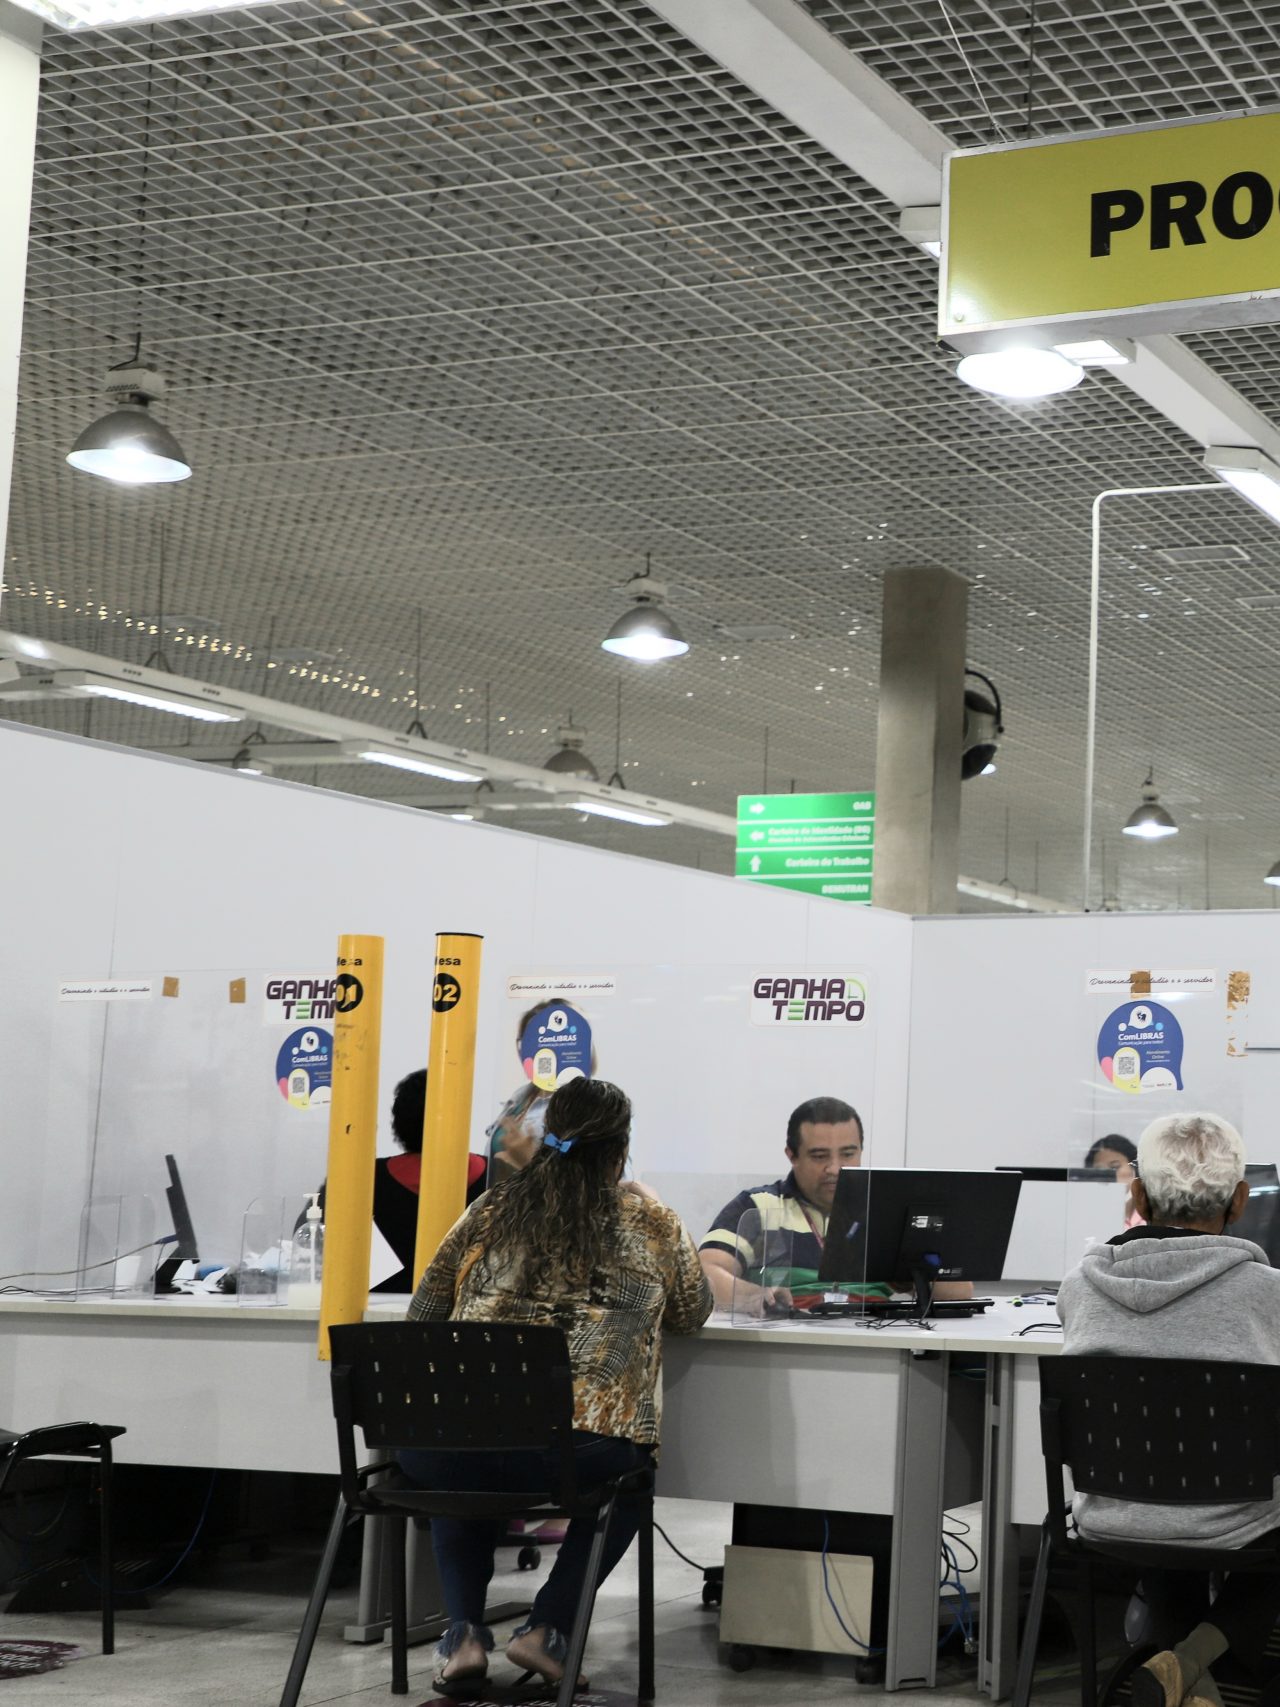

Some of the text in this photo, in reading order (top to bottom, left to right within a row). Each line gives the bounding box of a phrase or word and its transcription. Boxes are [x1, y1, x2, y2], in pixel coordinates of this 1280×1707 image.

[435, 956, 461, 966] esa
[434, 983, 458, 1002] 02
[753, 978, 845, 999] GANHA
[283, 1000, 336, 1019] TEM
[772, 1000, 865, 1021] TEMPO
[538, 1034, 577, 1043] ComLIBRAS
[1118, 1032, 1164, 1040] ComLIBRAS
